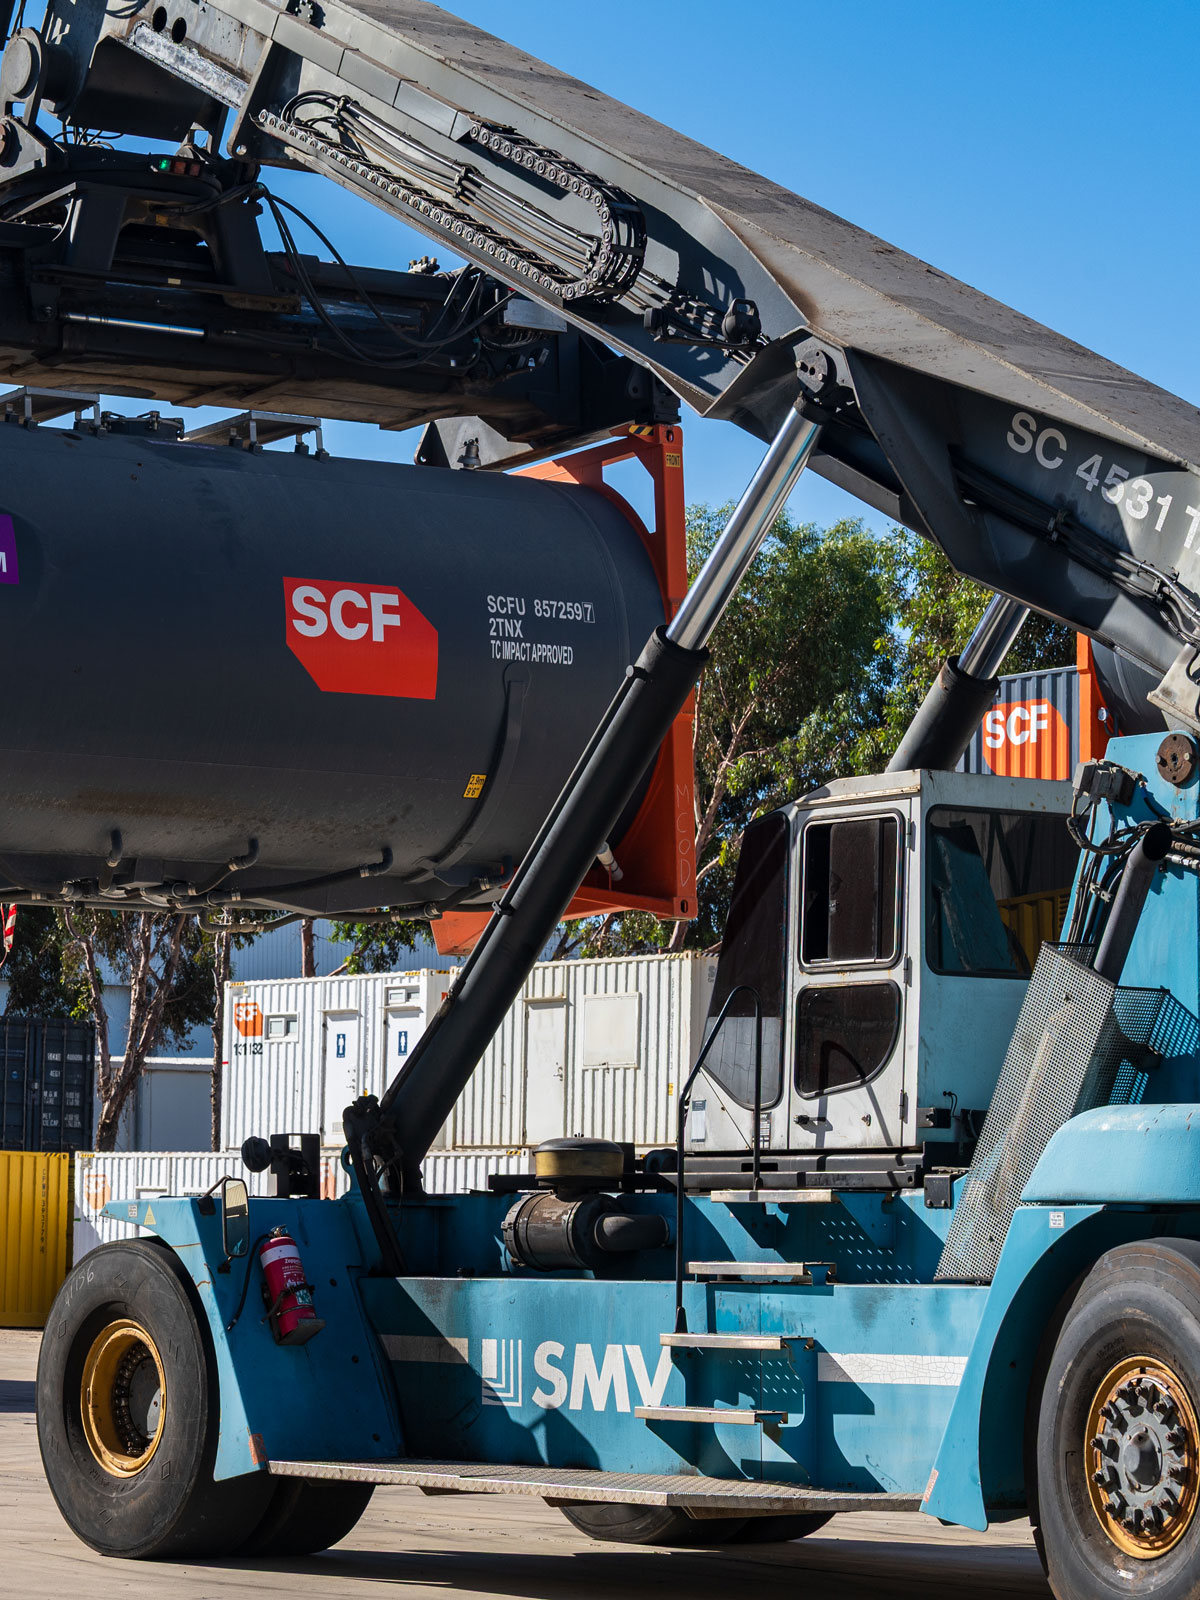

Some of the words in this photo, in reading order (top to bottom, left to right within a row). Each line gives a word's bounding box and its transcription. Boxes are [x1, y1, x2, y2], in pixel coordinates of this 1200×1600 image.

[666, 453, 681, 467] FRONT
[1006, 411, 1067, 470] SC
[1075, 453, 1173, 532] 4531
[1183, 504, 1200, 556] T
[291, 585, 402, 642] SCF
[487, 594, 526, 616] SCFU
[534, 598, 596, 624] 8572597
[488, 618, 524, 639] 2TNX
[490, 640, 502, 660] TC
[502, 641, 531, 663] IMPACT
[531, 643, 574, 665] APPROVED
[985, 703, 1048, 749] SCF
[675, 783, 692, 888] MCOD
[236, 1004, 258, 1022] SCF
[532, 1340, 672, 1413] SMV
